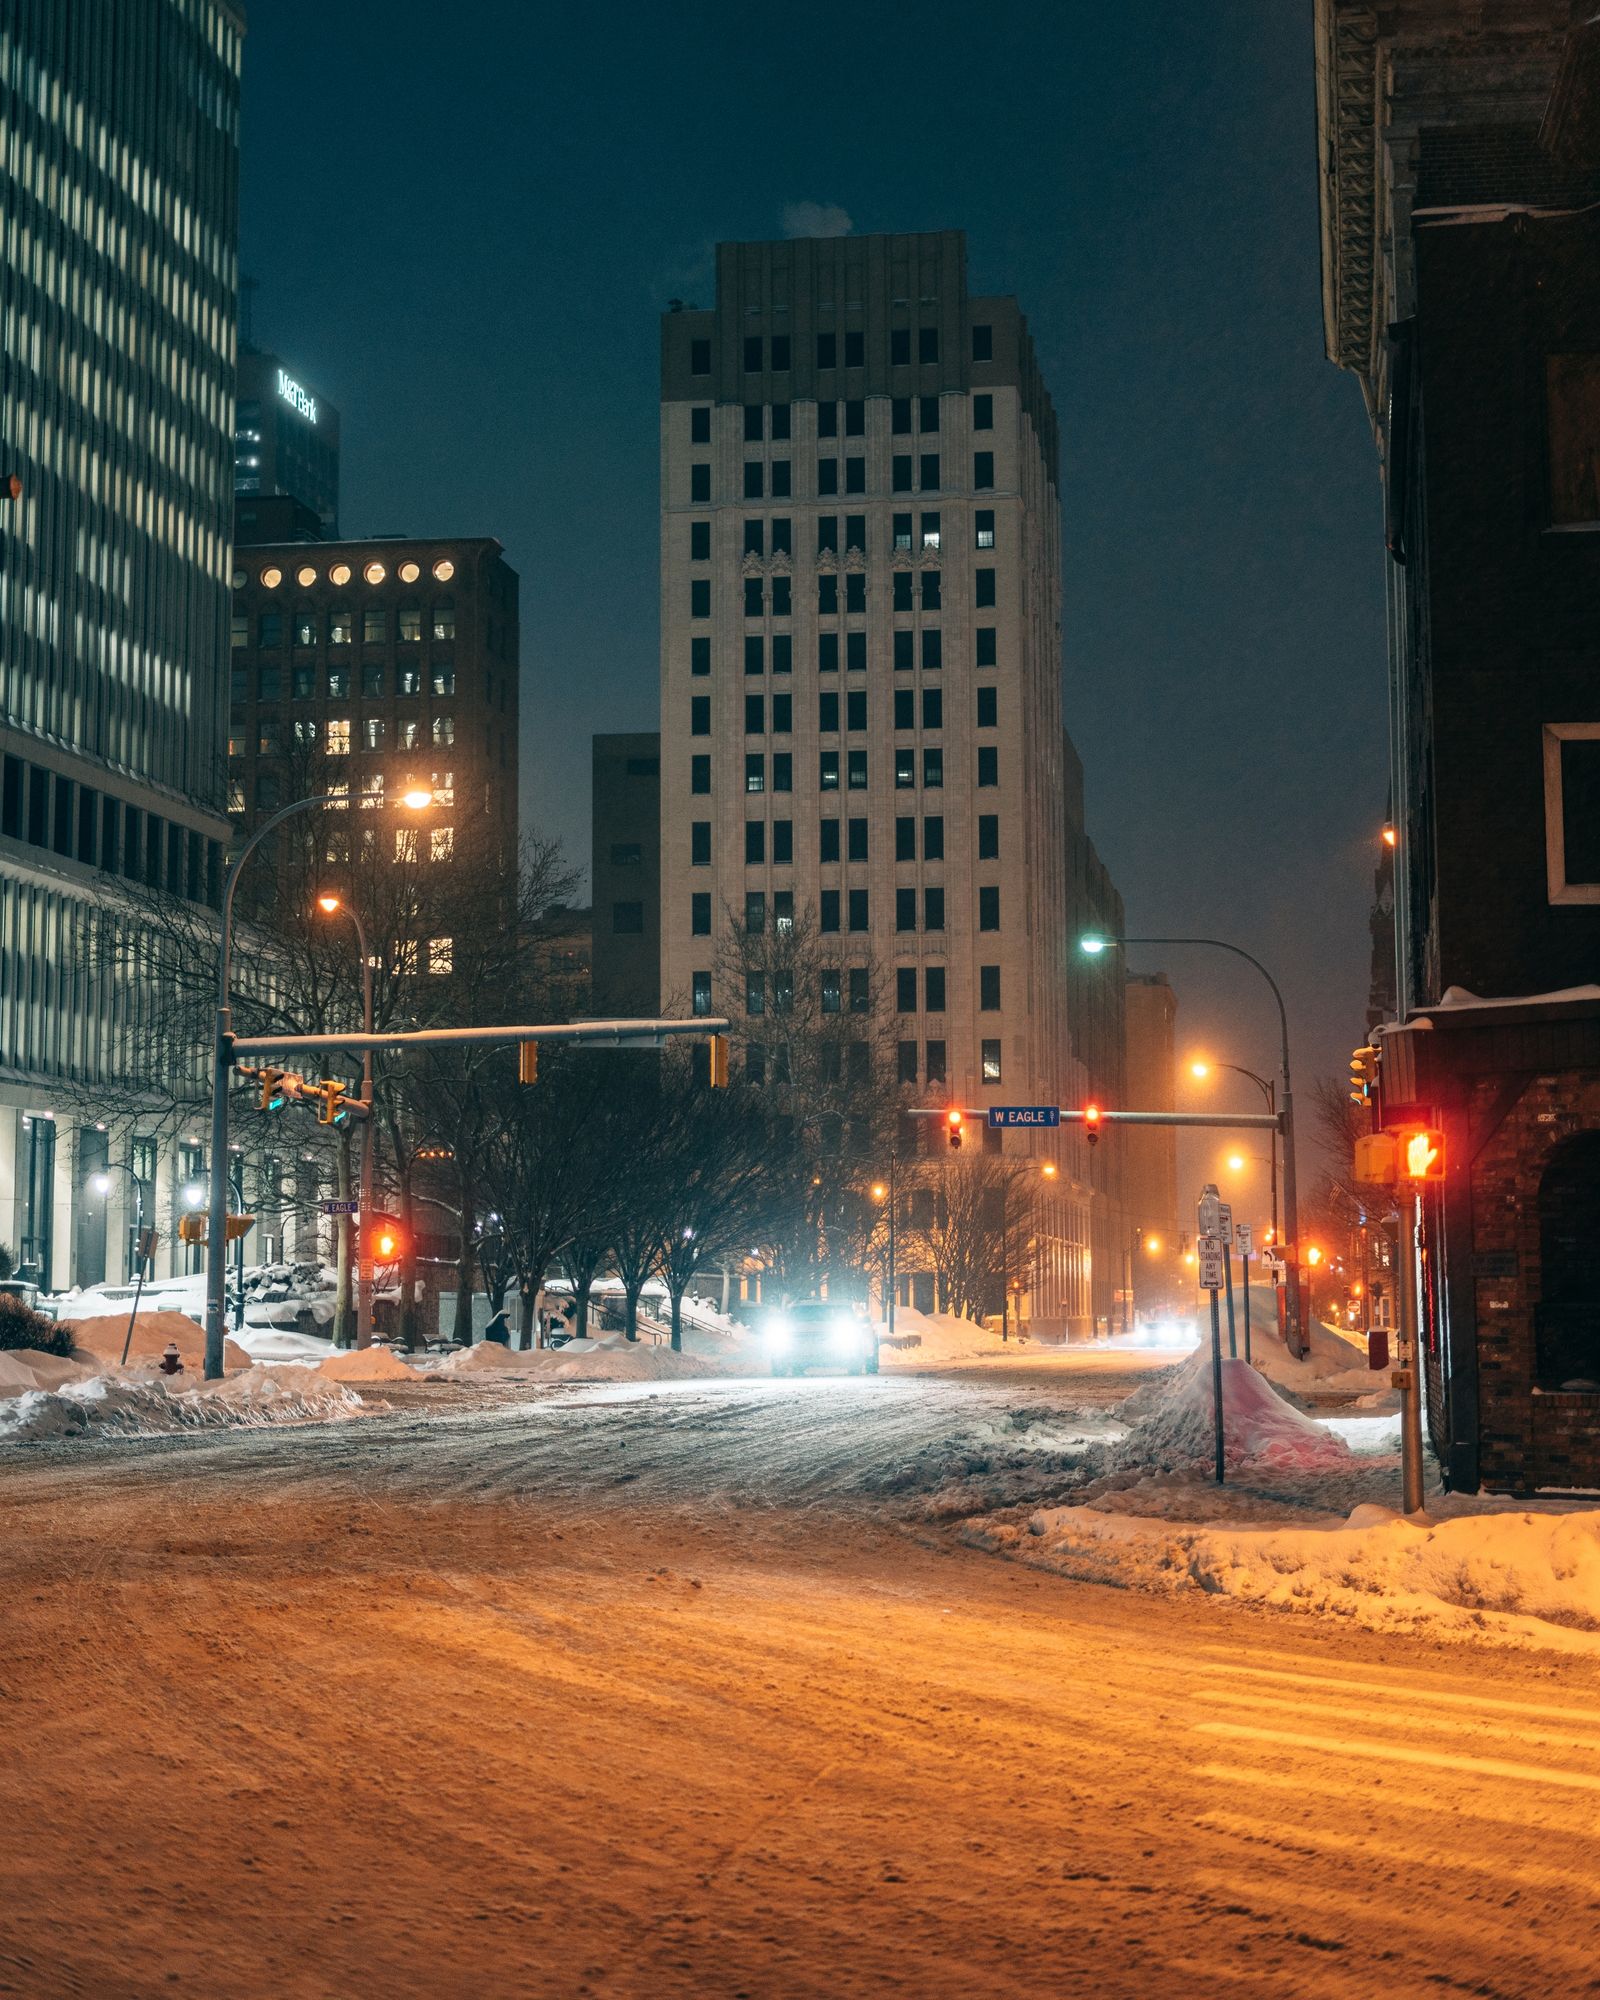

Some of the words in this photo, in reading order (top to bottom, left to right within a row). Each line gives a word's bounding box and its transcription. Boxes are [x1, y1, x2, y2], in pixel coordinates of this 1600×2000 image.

[278, 369, 299, 408] M&T
[298, 387, 317, 424] Bank
[995, 1111, 1004, 1122] W
[1008, 1111, 1045, 1123] EAGLE
[331, 1203, 352, 1213] EAGLE
[1205, 1240, 1215, 1250] NO
[1205, 1262, 1216, 1270] ANY
[1205, 1270, 1217, 1279] TIME
